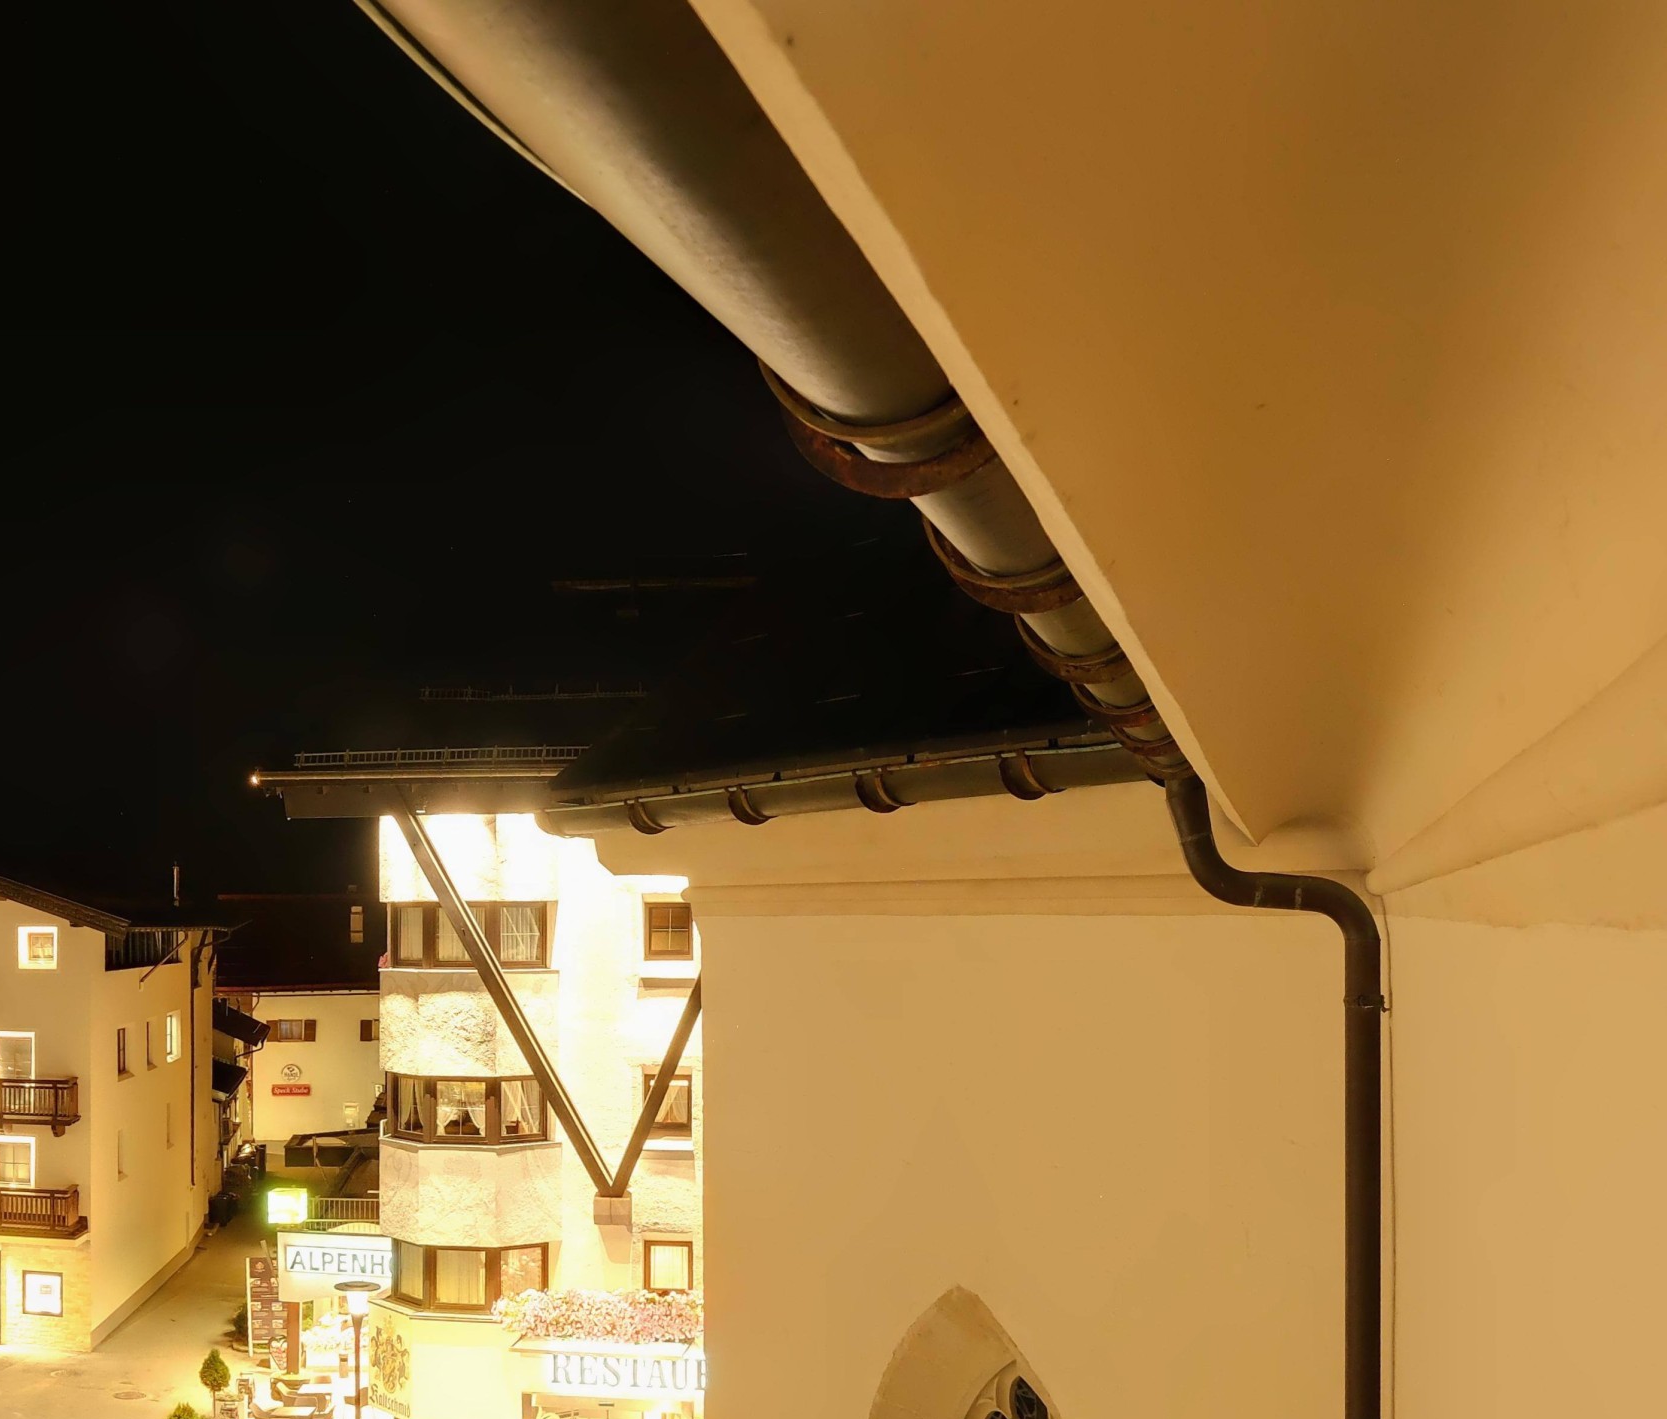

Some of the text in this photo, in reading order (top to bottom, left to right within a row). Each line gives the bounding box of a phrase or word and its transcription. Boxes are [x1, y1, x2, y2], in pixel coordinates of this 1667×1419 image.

[274, 1087, 309, 1096] Speck Stube
[289, 1250, 392, 1275] ALPENH
